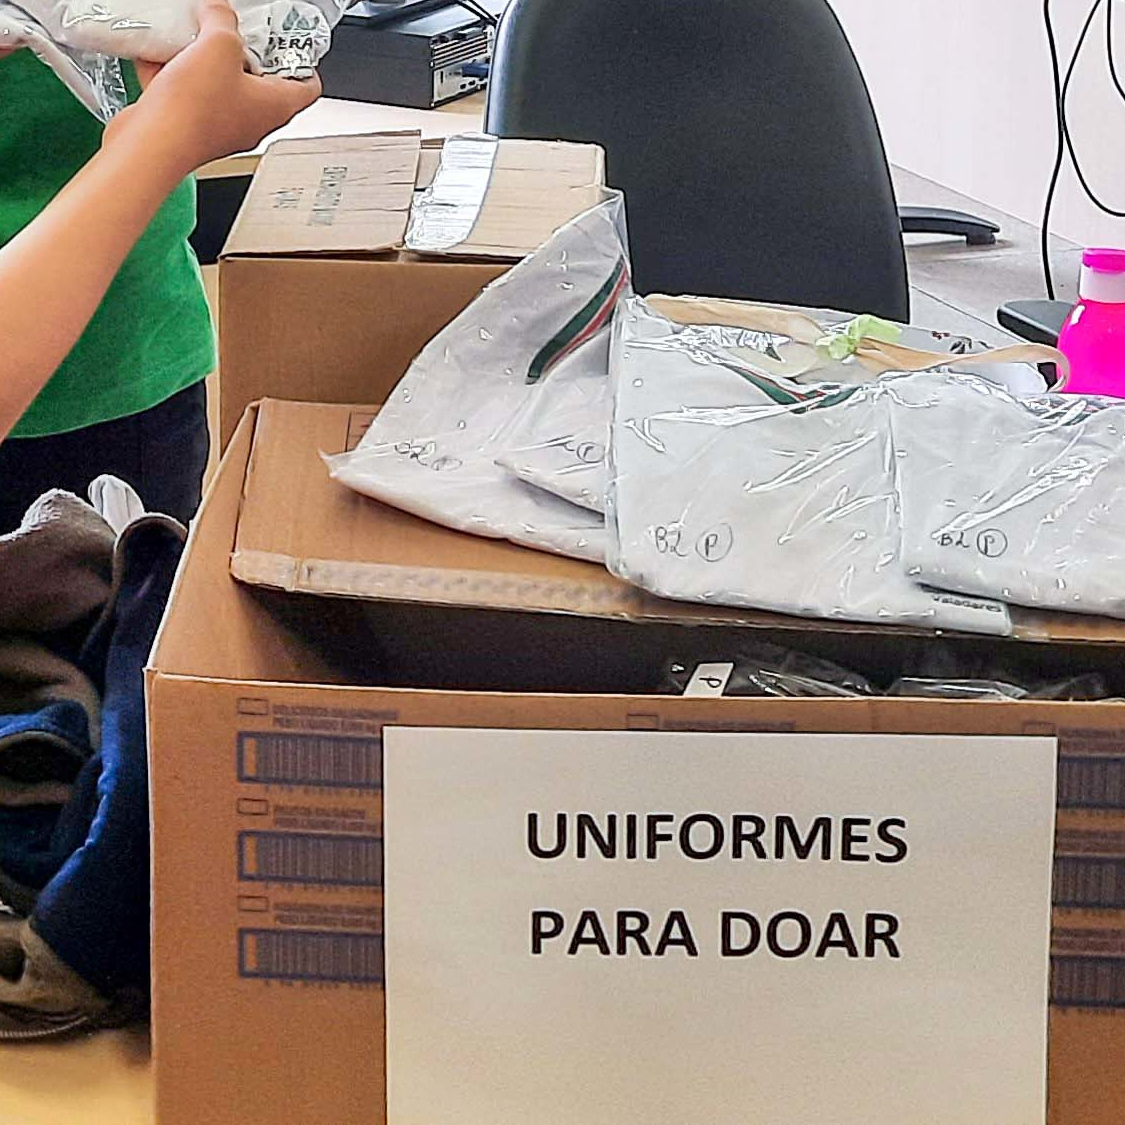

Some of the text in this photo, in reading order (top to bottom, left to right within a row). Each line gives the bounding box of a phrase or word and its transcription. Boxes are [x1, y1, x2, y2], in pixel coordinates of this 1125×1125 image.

[527, 812, 908, 864] UNIFORMES
[530, 910, 901, 959] PARA DOAR
